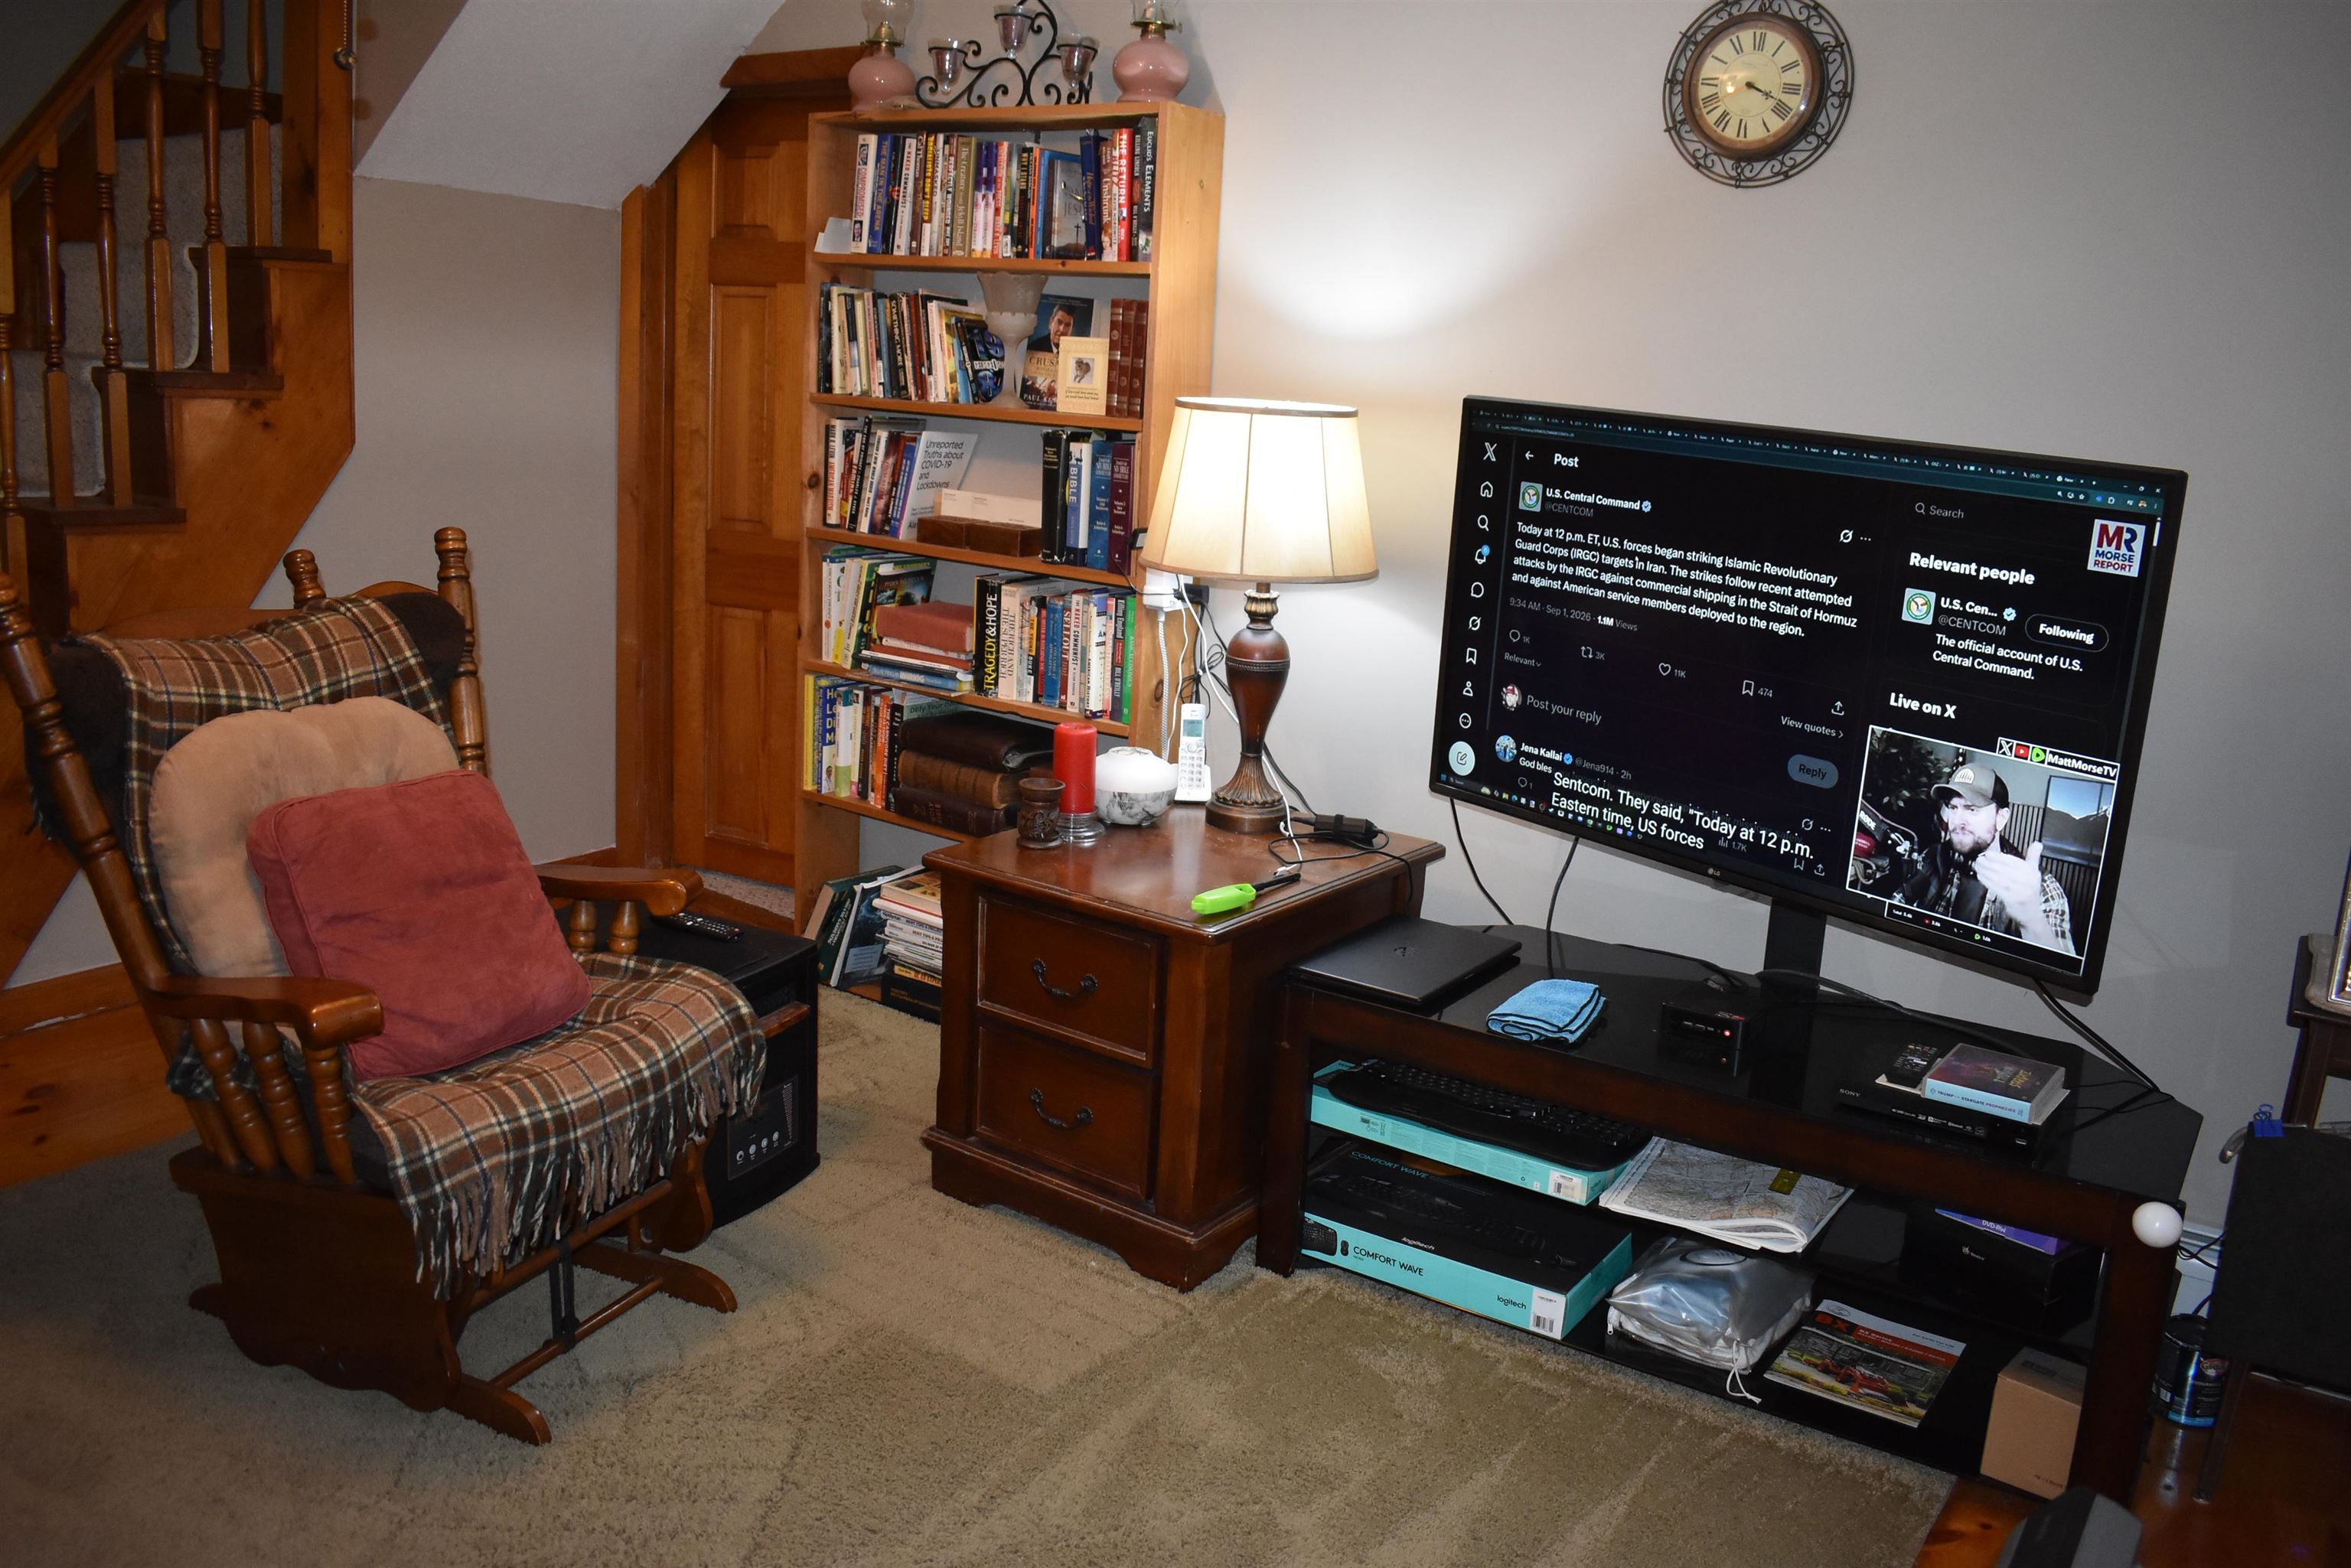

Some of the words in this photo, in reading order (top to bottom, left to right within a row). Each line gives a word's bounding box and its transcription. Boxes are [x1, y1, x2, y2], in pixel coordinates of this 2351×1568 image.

[1119, 133, 1127, 155] THE
[915, 148, 923, 178] Thomas
[901, 173, 910, 208] COMMUNIST
[1118, 158, 1127, 204] RETURN
[1143, 165, 1154, 213] ELEMENTS
[1102, 178, 1111, 224] Unshrunk
[891, 299, 901, 347] SOMETHING
[896, 347, 905, 367] MORE
[1023, 393, 1040, 401] PAUL
[924, 450, 941, 458] Truths
[943, 451, 964, 459] about
[925, 440, 964, 449] Unreported
[921, 460, 952, 469] COVID-19
[1554, 453, 1579, 468] Post
[916, 480, 950, 490] Lockdowns
[1069, 467, 1078, 503] BIBLE
[1544, 501, 1593, 517] @CENTCOM
[1546, 487, 1562, 498] U.S.
[1564, 490, 1595, 503] Central
[1596, 494, 1640, 510] Command
[1929, 505, 1964, 518] Search
[2097, 523, 2137, 553] MR
[1517, 521, 1543, 537] Today
[1543, 527, 1553, 537] at
[1554, 528, 1564, 539] 12
[1565, 532, 1585, 543] p.m.
[1587, 533, 1600, 546] ET,
[1603, 536, 1621, 549] U.S.
[1623, 539, 1652, 554] forces
[1654, 544, 1684, 559] began
[1685, 550, 1723, 568] striking
[1724, 556, 1761, 572] Islamic
[1762, 562, 1837, 587] Revolutionary
[2095, 549, 2135, 563] MORSE
[1515, 538, 1541, 552] Guard
[1542, 543, 1569, 557] Corps
[1570, 547, 1599, 563] (IRGC)
[1601, 553, 1634, 569] targets
[1635, 559, 1645, 572] in
[1645, 560, 1667, 574] Iran.
[1669, 564, 1688, 578] The
[1689, 569, 1723, 584] strikes
[1725, 574, 1756, 590] follow
[1758, 582, 1792, 596] recent
[1794, 588, 1852, 607] attempted
[1909, 552, 1978, 575] Relevant
[1978, 566, 2035, 585] people
[2093, 559, 2134, 572] REPORT
[1513, 556, 1545, 569] attacks
[1546, 560, 1557, 574] by
[1559, 562, 1573, 575] the
[1575, 566, 1599, 579] IRGC
[1599, 572, 1634, 585] against
[1635, 579, 1691, 596] commercial
[1692, 587, 1736, 607] shipping
[1737, 594, 1747, 607] in
[1749, 597, 1767, 611] the
[1768, 601, 1798, 617] Strait
[1799, 607, 1812, 618] of
[1813, 608, 1857, 628] Hormuz
[985, 593, 996, 625] HOPE
[1116, 599, 1124, 616] Killing
[1508, 596, 1524, 608] 9:34
[1524, 599, 1541, 612] AM
[1545, 604, 1560, 618] Sep
[1567, 608, 1592, 623] 2026
[1596, 614, 1614, 628] 1.1M
[1615, 618, 1638, 633] Views
[1511, 572, 1528, 583] and
[1529, 576, 1561, 589] against
[1562, 580, 1605, 598] American
[1606, 591, 1640, 605] service
[1641, 597, 1687, 614] members
[1687, 604, 1735, 623] deployed
[1736, 614, 1747, 625] to
[1749, 616, 1767, 629] the
[1769, 621, 1805, 637] region.
[1940, 596, 1963, 611] U.S.
[1061, 610, 1071, 660] SELLOUT
[1115, 617, 1123, 638] England
[1938, 614, 2006, 636] @CENTCOM
[2039, 623, 2094, 644] Following
[1071, 630, 1079, 665] COMMUNIST
[1595, 651, 1605, 660] 3K
[1935, 633, 1956, 647] The
[1957, 638, 1995, 654] official
[1996, 647, 2043, 663] account
[2044, 655, 2058, 667] of
[2059, 657, 2082, 671] U.S.
[983, 636, 997, 689] TRAGEDY
[1504, 652, 1534, 667] Relevant
[1932, 650, 1972, 667] Central
[1974, 658, 2034, 680] Command.
[898, 670, 925, 683] WIRING
[1674, 669, 1686, 678] 11K
[1757, 687, 1772, 697] 474
[1526, 694, 1549, 710] Post
[1550, 703, 1573, 716] your
[1576, 709, 1601, 725] reply
[1890, 692, 1920, 711] Live
[1922, 703, 1942, 716] on
[1943, 703, 1957, 719] X
[1781, 716, 1802, 729] View
[1804, 723, 1836, 736] quotes
[1518, 757, 1535, 768] God
[1520, 742, 1538, 755] Jena
[1539, 747, 1562, 761] Kallai
[1575, 758, 1613, 775] @Jena914
[1620, 769, 1631, 780] 2h
[1798, 763, 1828, 781] Reply
[2046, 751, 2117, 777] MattMorseTV
[1551, 791, 1599, 820] Eastern
[1602, 807, 1634, 833] time,
[1637, 817, 1657, 836] US
[1660, 823, 1704, 849] forces
[1553, 771, 1612, 801] Sentcom.
[1617, 789, 1650, 814] They
[1652, 802, 1684, 823] said,
[1739, 827, 1755, 846] at
[1759, 830, 1777, 848] 12
[1780, 839, 1813, 864] p.m.
[1839, 1088, 1861, 1097] SONY
[1937, 1090, 1955, 1099] TRUMP
[1961, 1097, 1984, 1107] STARGATE
[1985, 1102, 2016, 1113] PROPHECIES
[1350, 1150, 1400, 1171] COMFORT
[1400, 1165, 1429, 1180] WAVE
[1981, 1219, 2007, 1234] DVD-RW
[1401, 1237, 1435, 1251] logitech
[1353, 1245, 1397, 1267] COMFORT
[1398, 1260, 1424, 1276] WAVE
[1497, 1295, 1527, 1310] logitech
[1812, 1312, 1850, 1333] BX
